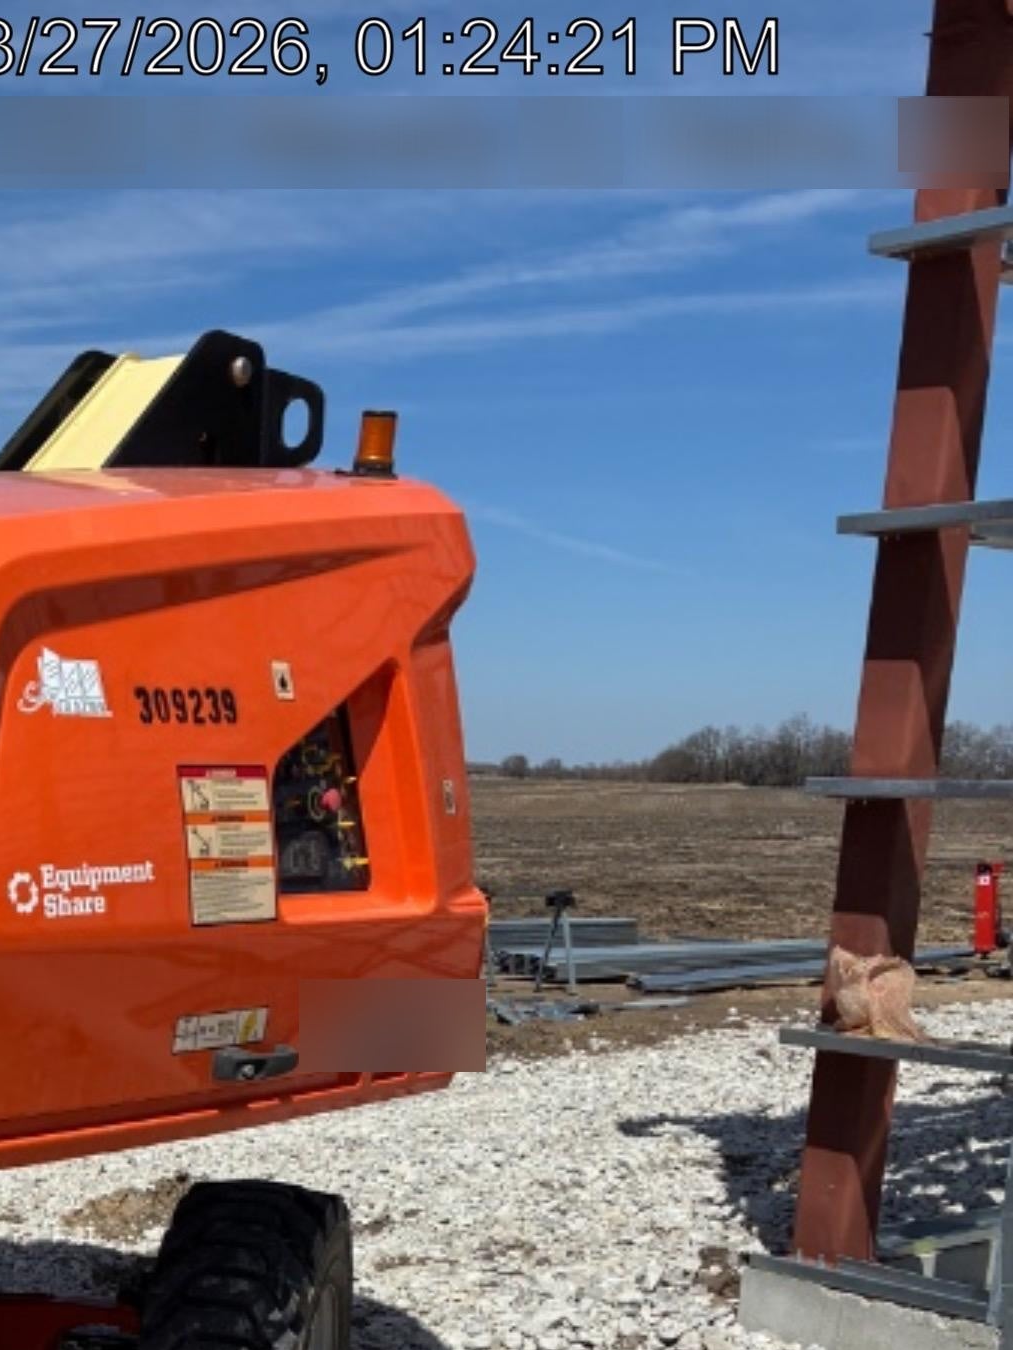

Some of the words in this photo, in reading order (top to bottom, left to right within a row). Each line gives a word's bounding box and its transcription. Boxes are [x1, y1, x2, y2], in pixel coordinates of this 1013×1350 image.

[135, 686, 237, 725] 309239
[40, 859, 156, 892] Equipment
[43, 892, 106, 918] Share
